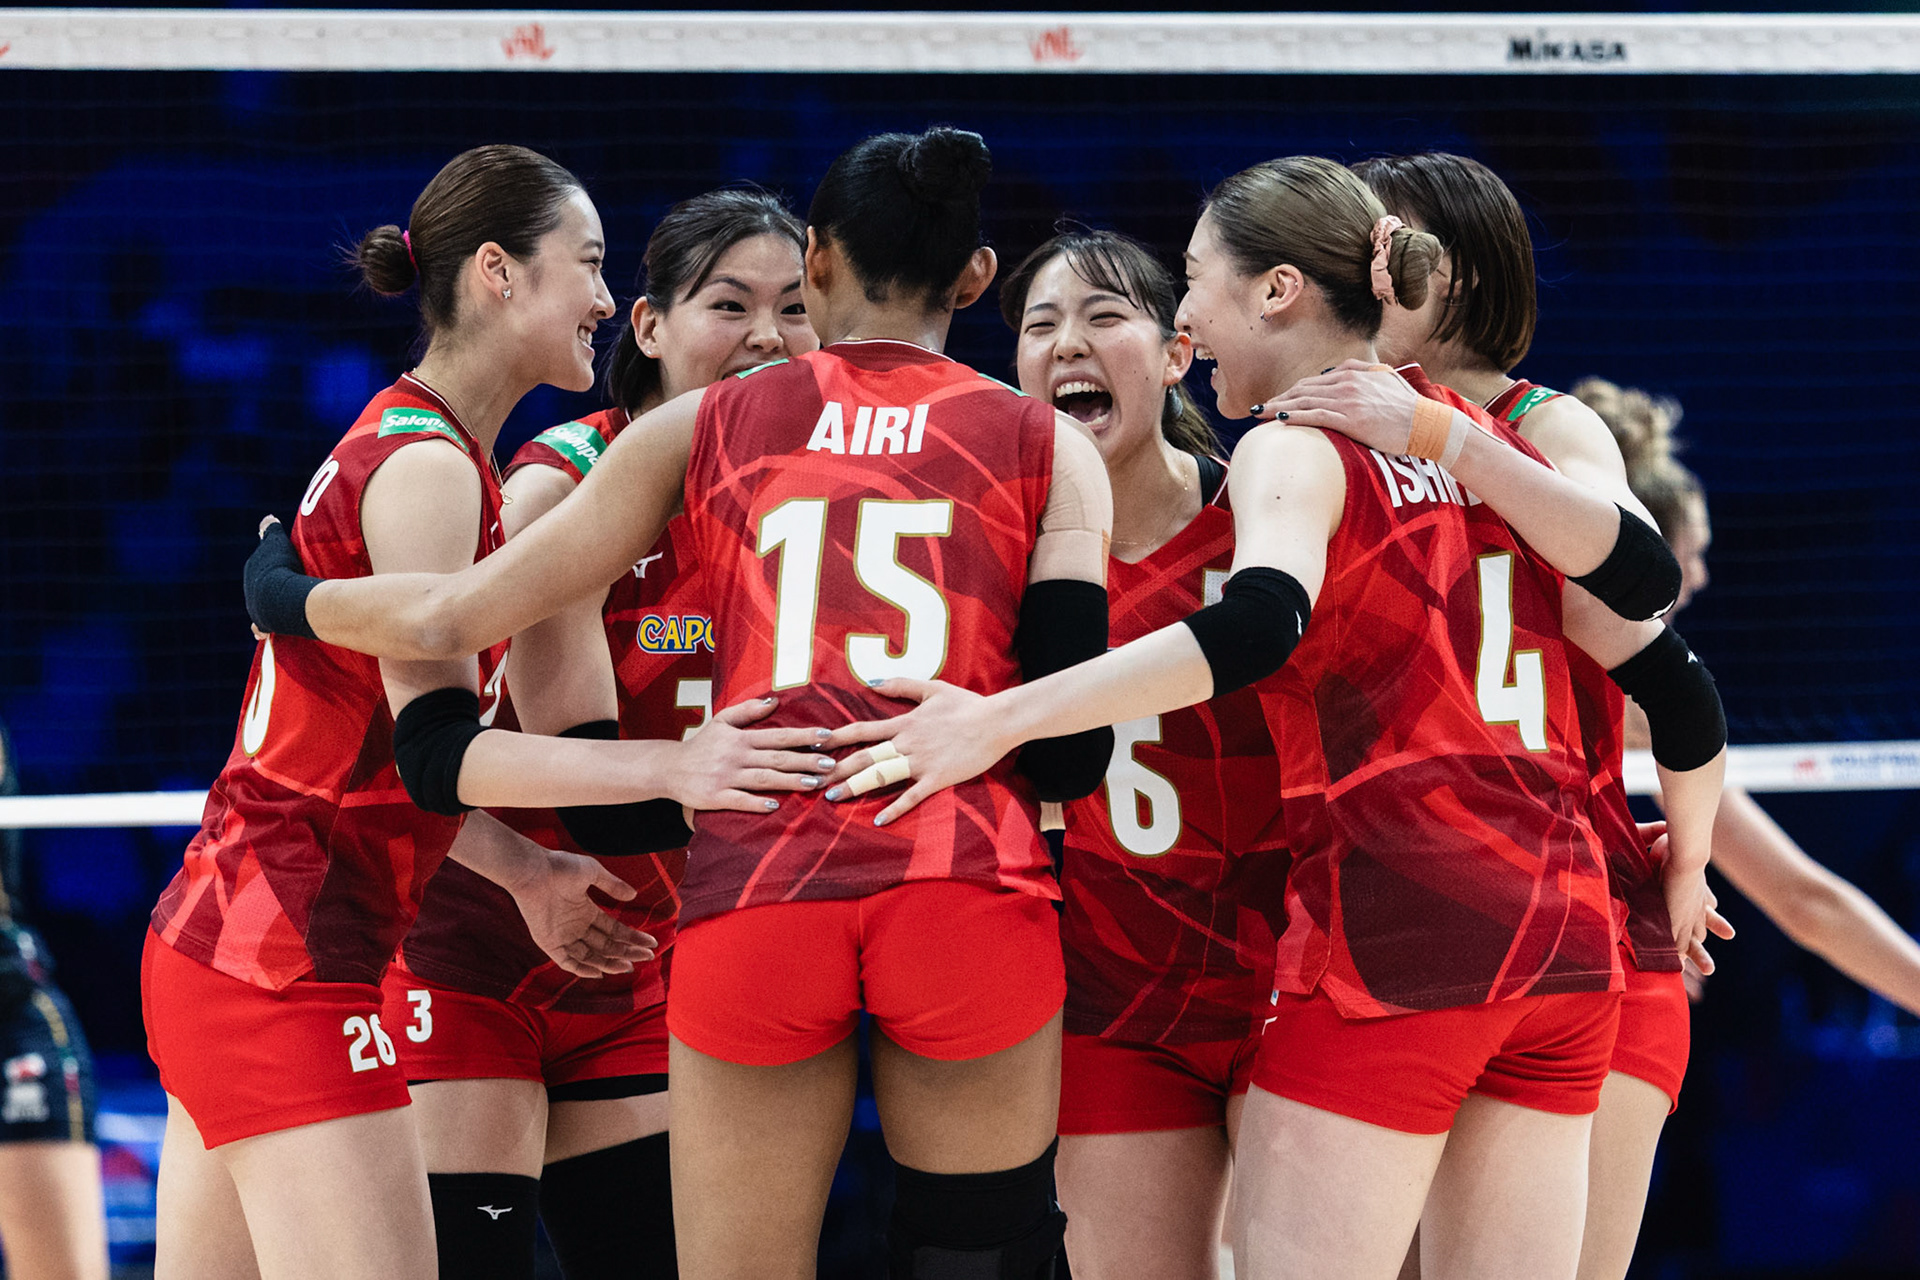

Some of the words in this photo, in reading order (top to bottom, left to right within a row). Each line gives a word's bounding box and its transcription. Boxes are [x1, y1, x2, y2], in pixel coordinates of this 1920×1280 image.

[806, 401, 930, 455] AIRI
[756, 497, 954, 691] 15
[1475, 551, 1550, 753] 4
[1104, 713, 1184, 858] 6
[343, 1013, 397, 1073] 26
[406, 989, 433, 1043] 3
